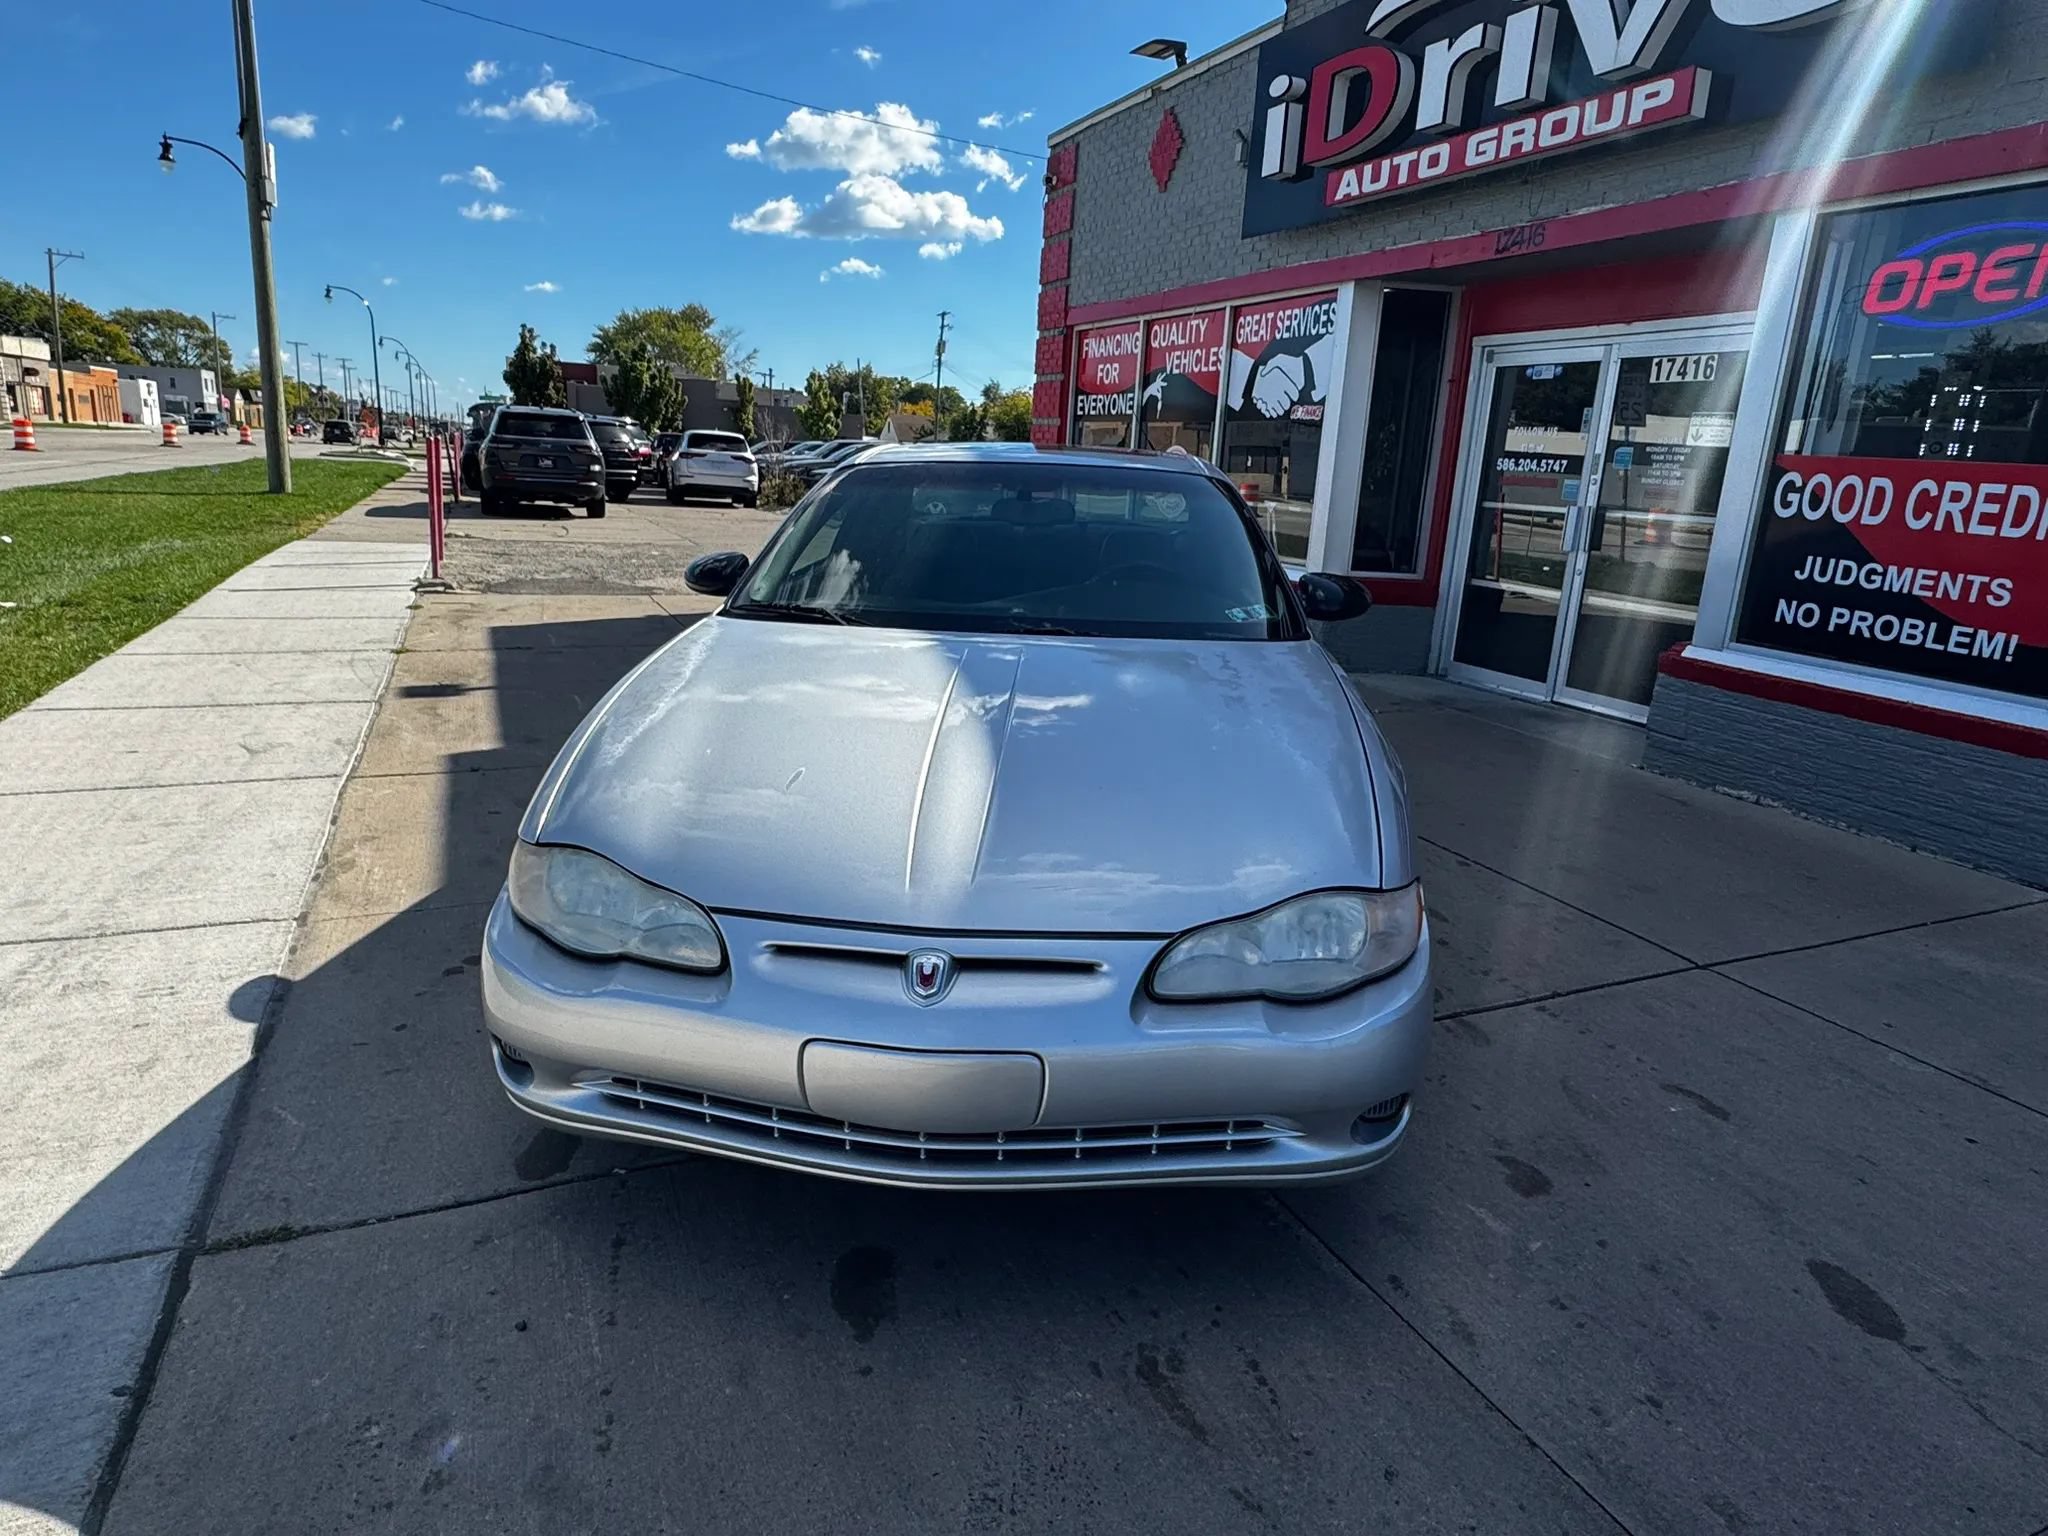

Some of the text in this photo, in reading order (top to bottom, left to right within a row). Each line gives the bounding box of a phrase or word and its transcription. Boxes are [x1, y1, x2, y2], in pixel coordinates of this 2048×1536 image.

[1260, 0, 1840, 179] iDriv
[1333, 77, 1676, 202] AUTO GROUP
[1150, 317, 1209, 349] QUALITY
[1236, 302, 1337, 345] GREAT SERVICES
[1082, 330, 1141, 360] FINANCING
[1165, 345, 1225, 375] VEHICLES
[1096, 362, 1120, 385] FOR
[1654, 355, 1716, 381] 17416
[1076, 393, 1134, 416] EVERYONE
[1496, 458, 1568, 473] 586.204.5747
[1773, 471, 1894, 526] GOOD
[1794, 555, 2014, 608] JUDGMENTS
[1774, 598, 2020, 663] NO PROBLEM!
